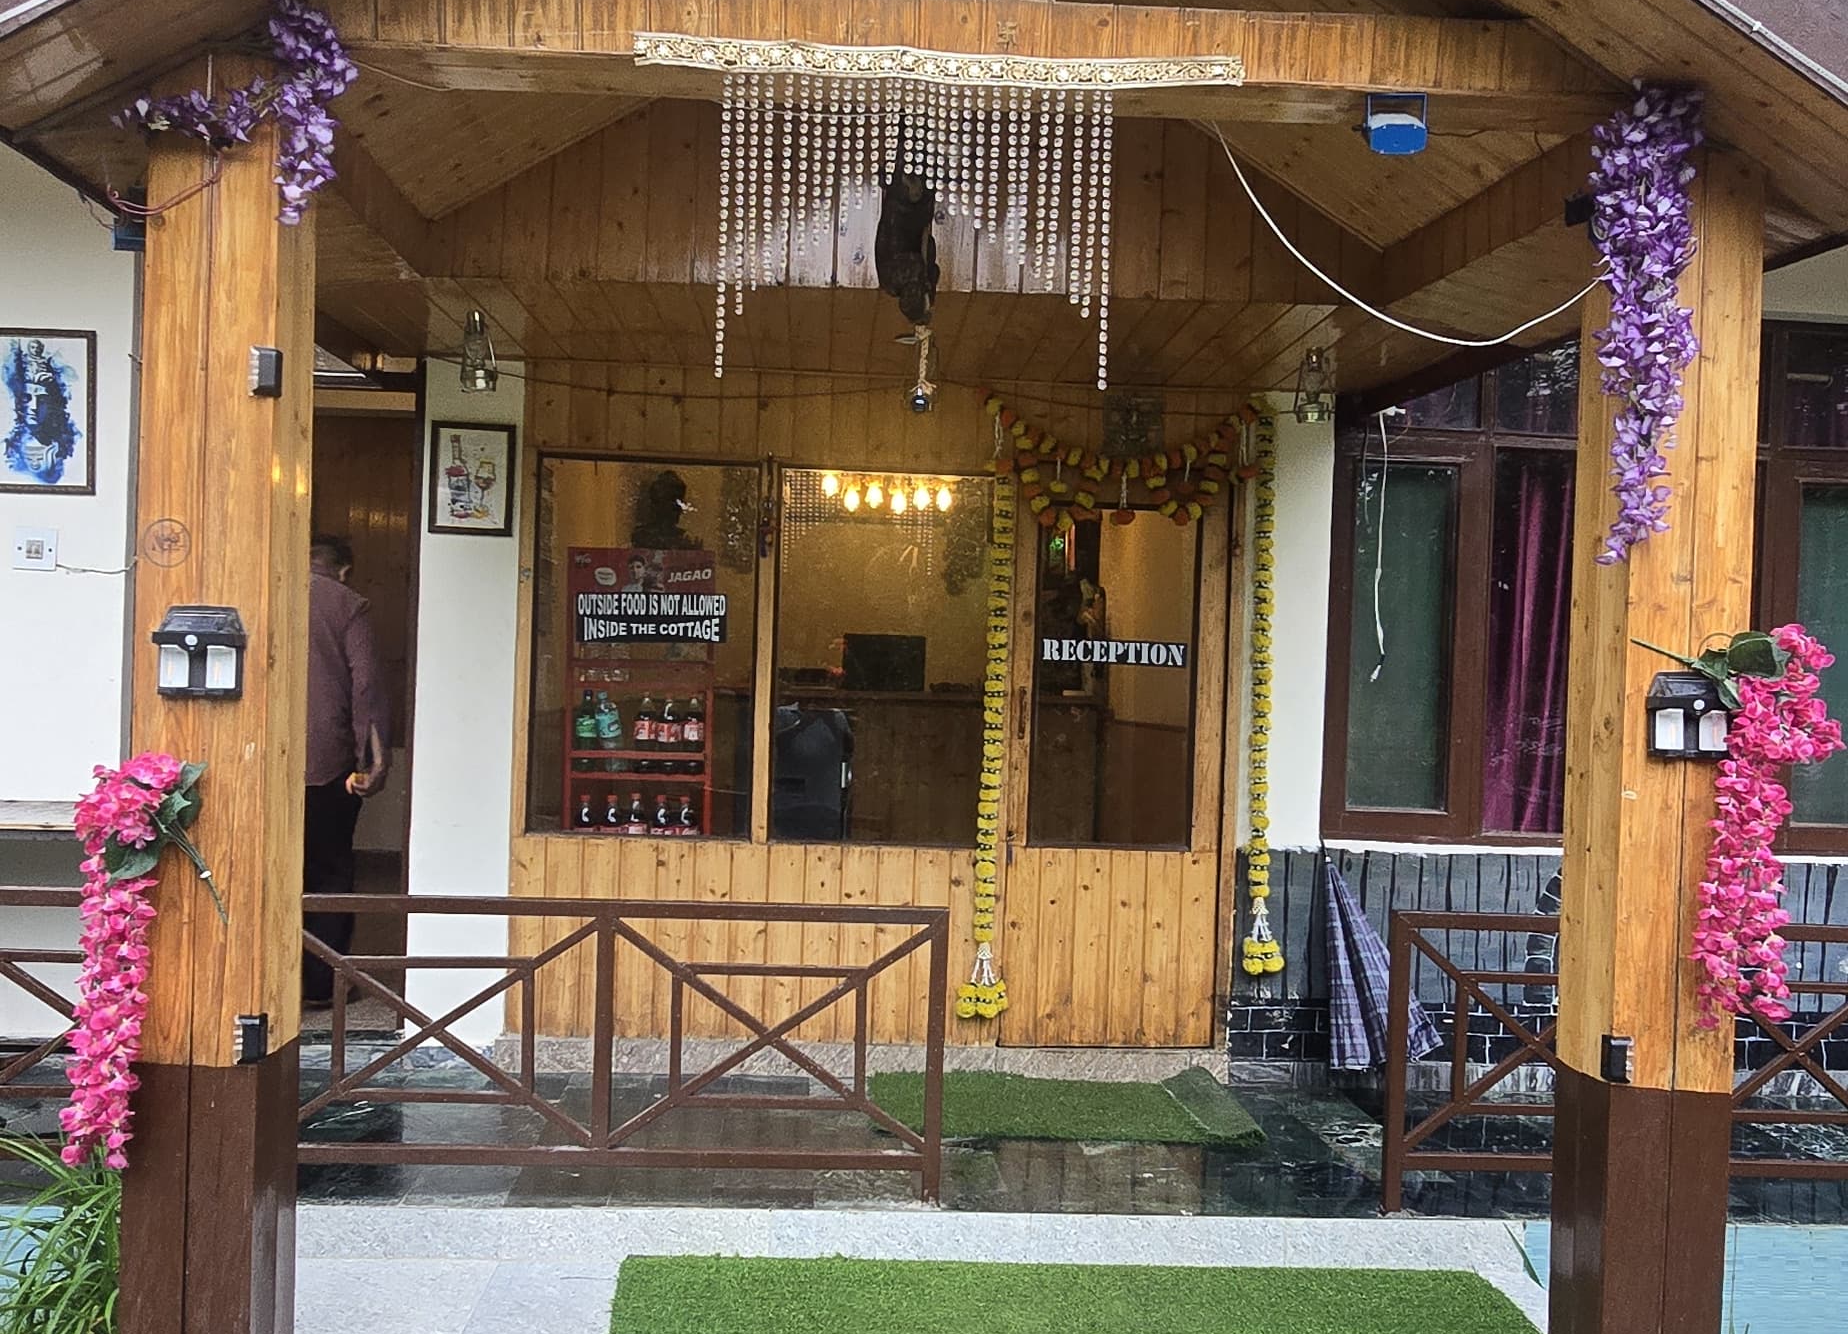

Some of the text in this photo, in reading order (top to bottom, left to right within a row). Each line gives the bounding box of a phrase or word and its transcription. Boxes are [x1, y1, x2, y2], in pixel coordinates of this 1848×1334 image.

[667, 568, 712, 583] JAGAO
[578, 593, 726, 616] OUTSIDE FOOD IS NOT ALLOWED
[584, 617, 720, 642] INSIDE THE COTTAGE
[1042, 638, 1185, 666] RECEPTION
